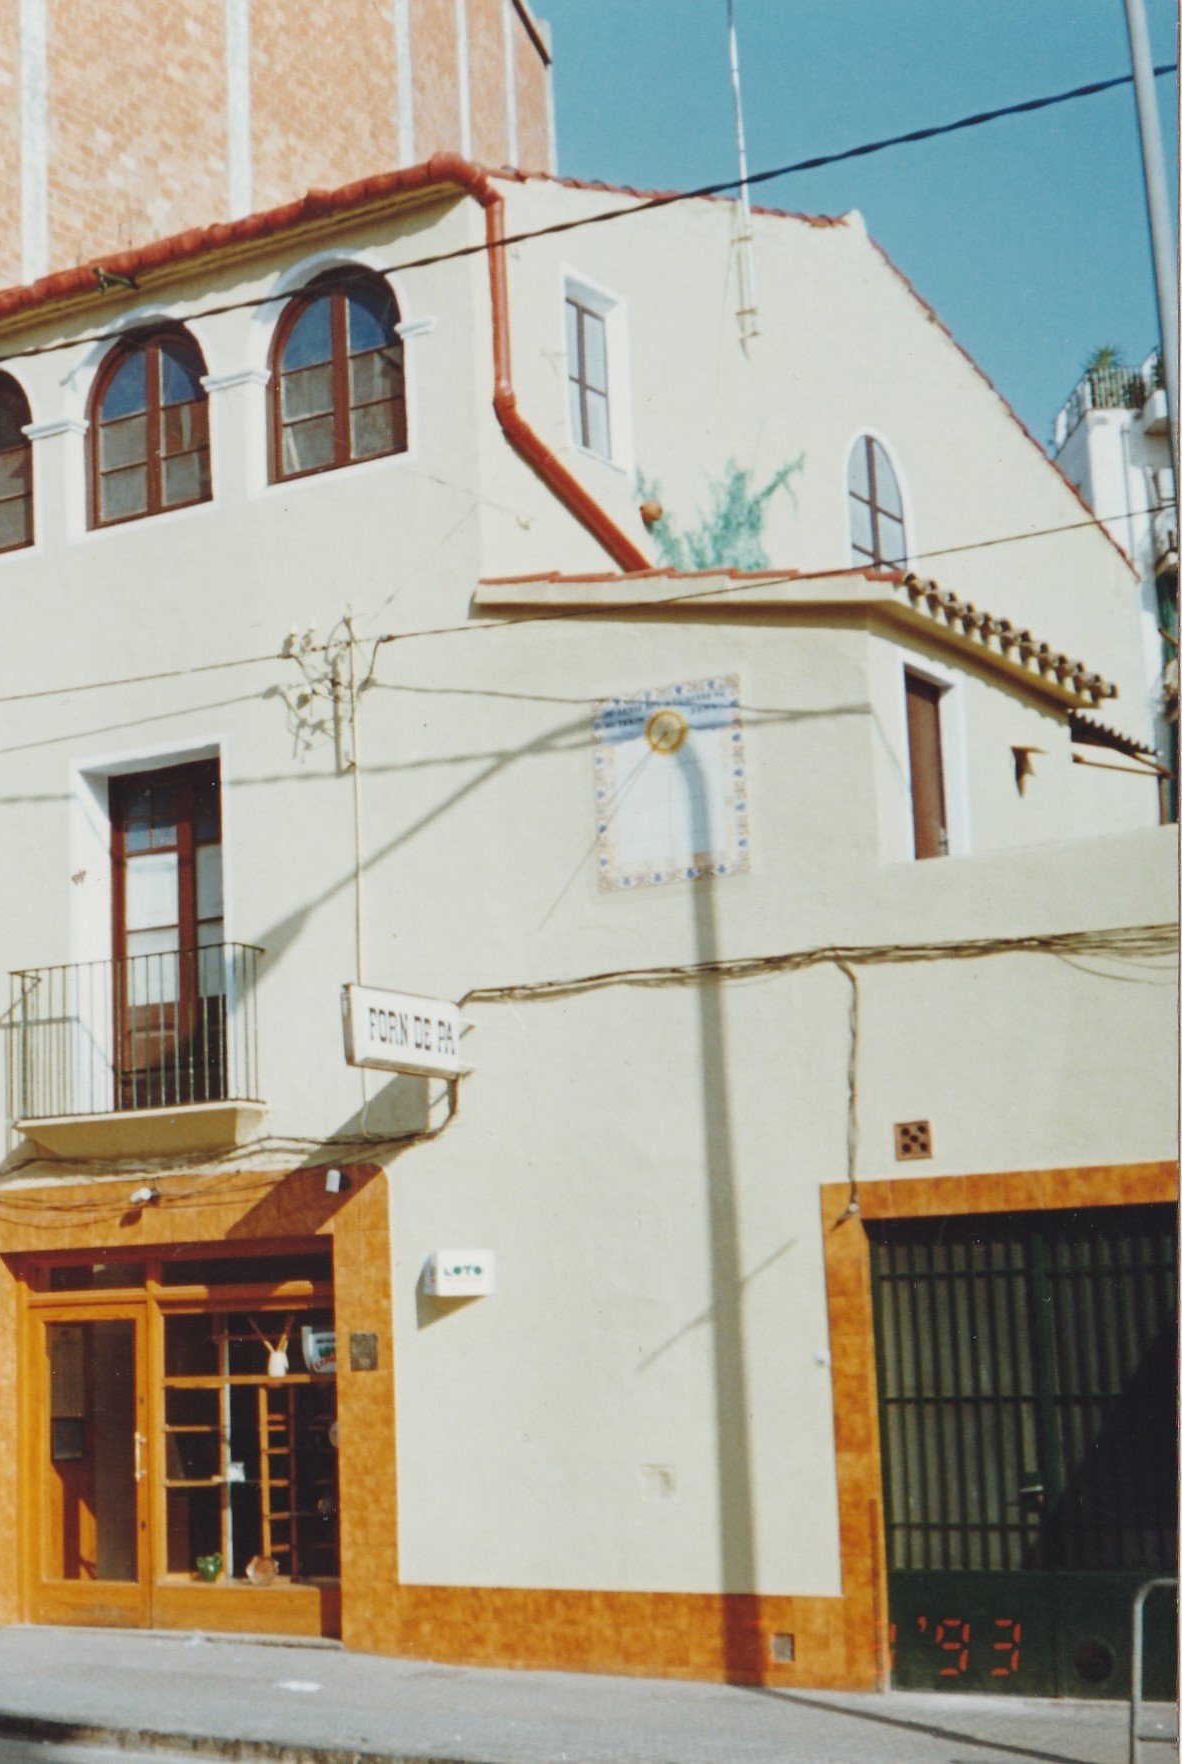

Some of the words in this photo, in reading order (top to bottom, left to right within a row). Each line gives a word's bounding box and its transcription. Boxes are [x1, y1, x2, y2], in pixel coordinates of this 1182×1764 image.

[369, 1007, 408, 1046] FORN
[415, 1016, 431, 1051] DE
[438, 1020, 455, 1055] PA
[444, 1265, 482, 1276] LOTO
